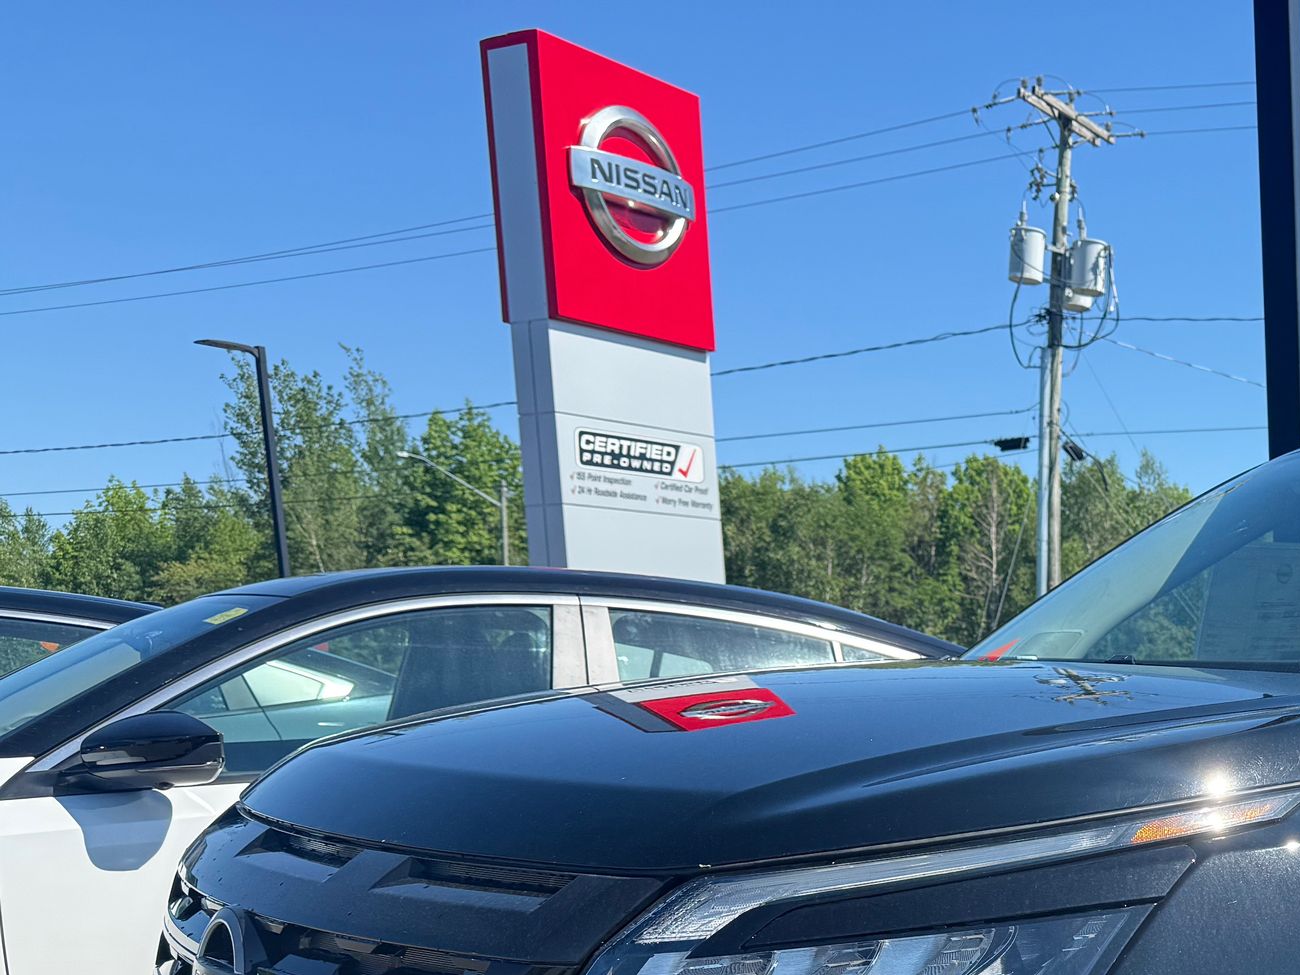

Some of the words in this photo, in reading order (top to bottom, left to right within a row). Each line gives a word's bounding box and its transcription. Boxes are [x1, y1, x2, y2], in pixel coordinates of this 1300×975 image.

[590, 157, 690, 210] NISSAN
[580, 434, 677, 462] CERTIFIED
[582, 451, 672, 473] PRE-OWNED
